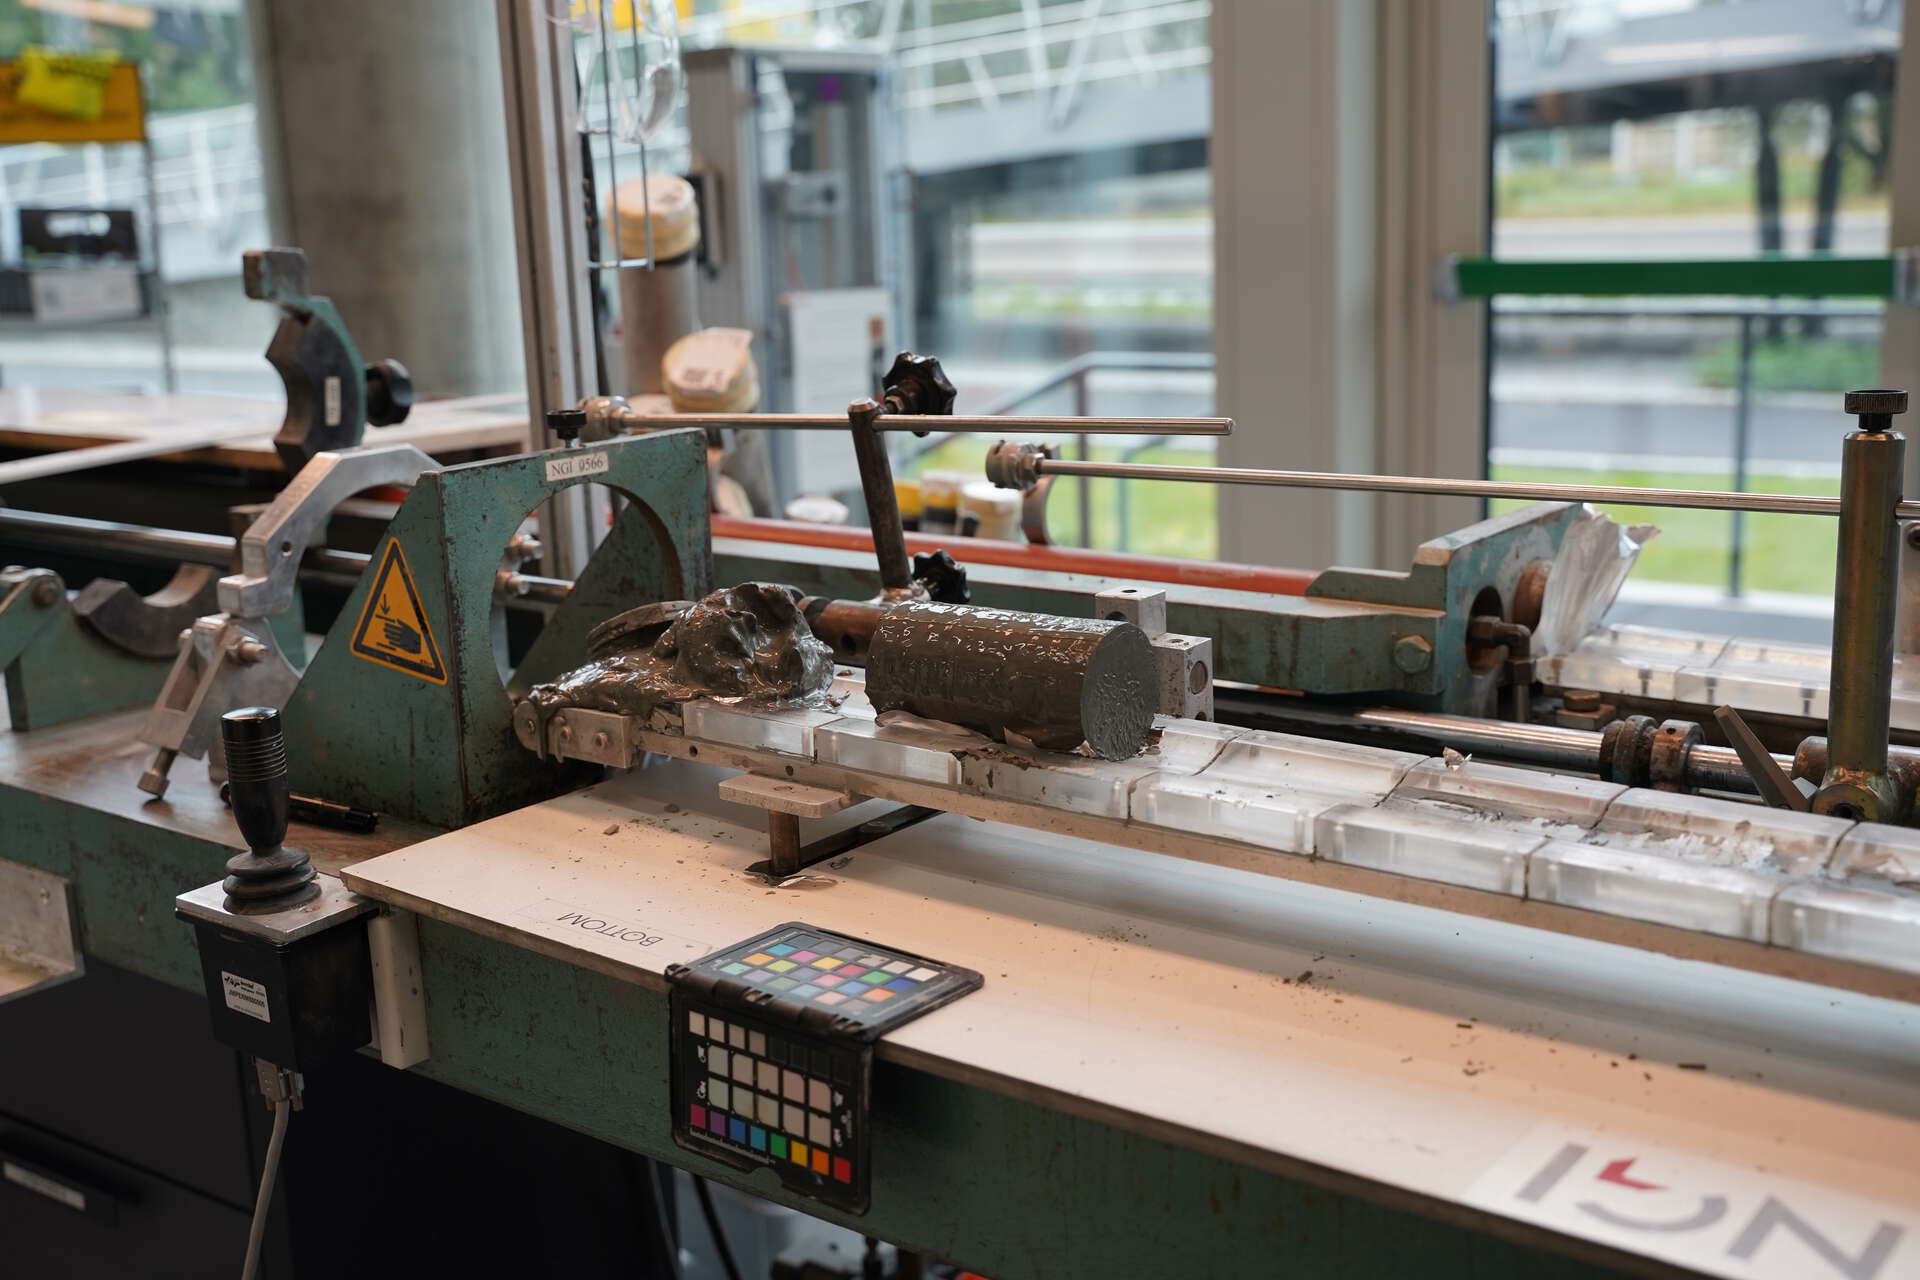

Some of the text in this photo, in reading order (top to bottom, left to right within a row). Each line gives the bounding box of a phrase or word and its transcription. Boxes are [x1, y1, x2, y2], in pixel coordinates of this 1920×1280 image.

[552, 458, 604, 476] NGI 0566
[556, 912, 664, 947] BOTTOM
[1514, 1141, 1907, 1280] NGI
